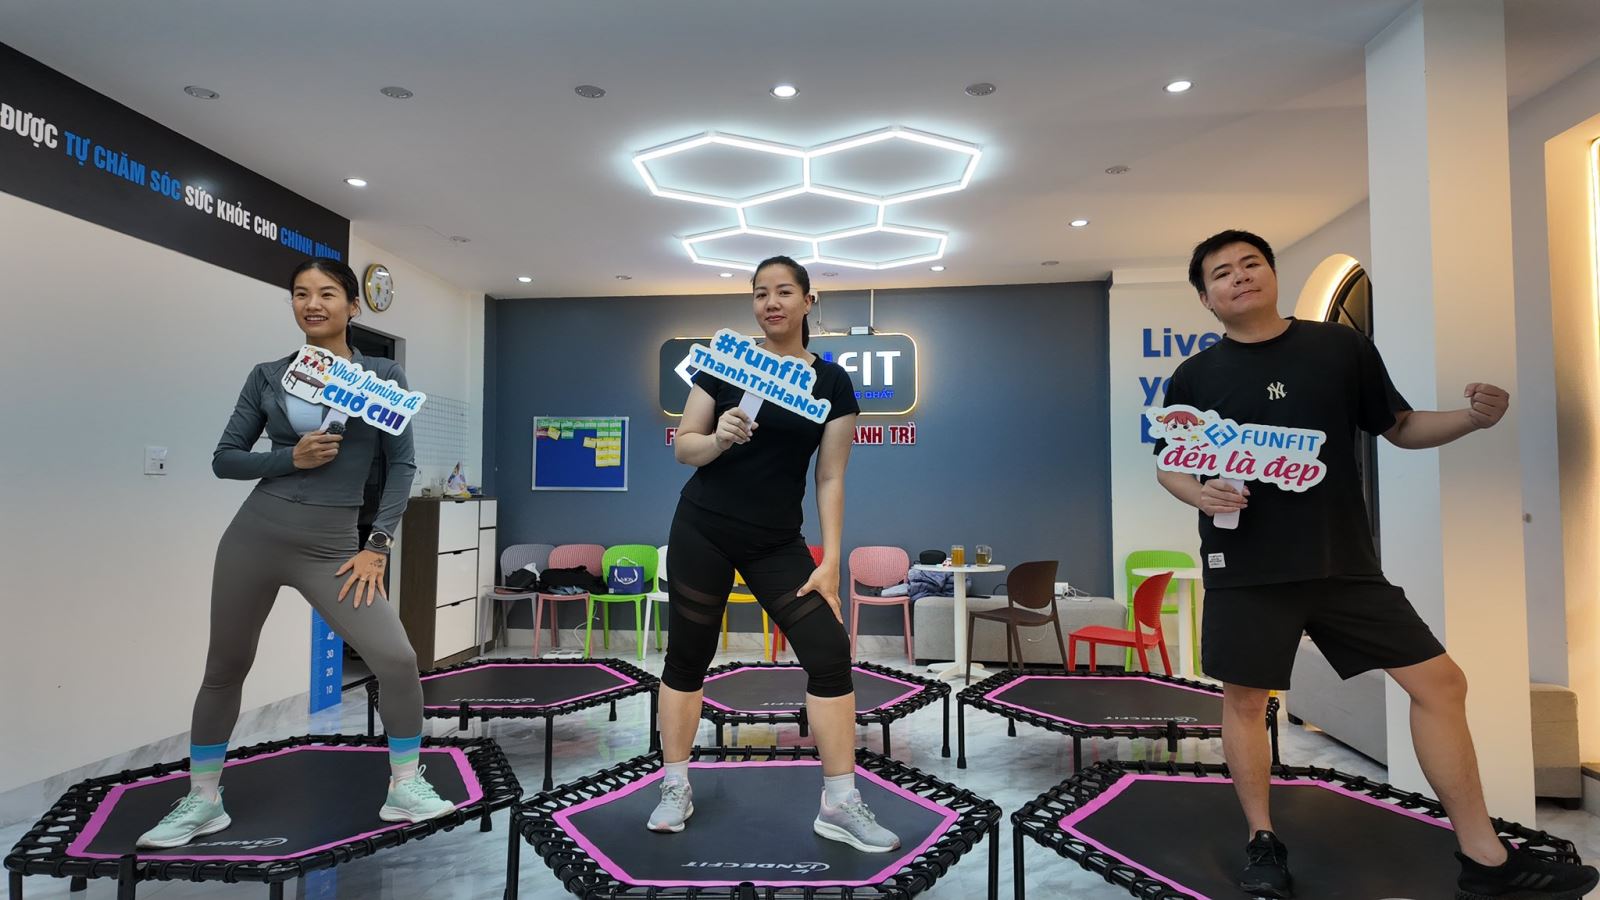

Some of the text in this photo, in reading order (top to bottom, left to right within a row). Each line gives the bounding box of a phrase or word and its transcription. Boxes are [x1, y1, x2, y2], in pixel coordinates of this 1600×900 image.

[0, 102, 58, 149] ĐƯỢC
[64, 130, 91, 166] TỰ
[93, 145, 146, 186] CHĂM
[150, 170, 181, 201] SÓC
[184, 185, 213, 214] SỨC
[216, 198, 251, 231] KHỎE
[254, 215, 278, 241] CHO
[280, 226, 313, 257] CHÍNH
[715, 333, 812, 391] #funfit
[1142, 328, 1223, 358] Live
[328, 360, 421, 410] Nhảy Juming đi
[694, 348, 827, 419] ThanhTriHaNoi
[823, 350, 901, 386] FIT
[322, 383, 406, 431] CHỜ CHI
[852, 425, 884, 445] ANH
[889, 422, 916, 445] TRÌ
[1240, 429, 1320, 452] FUNFIT
[1163, 442, 1321, 487] đến là đẹp
[326, 685, 333, 695] 10
